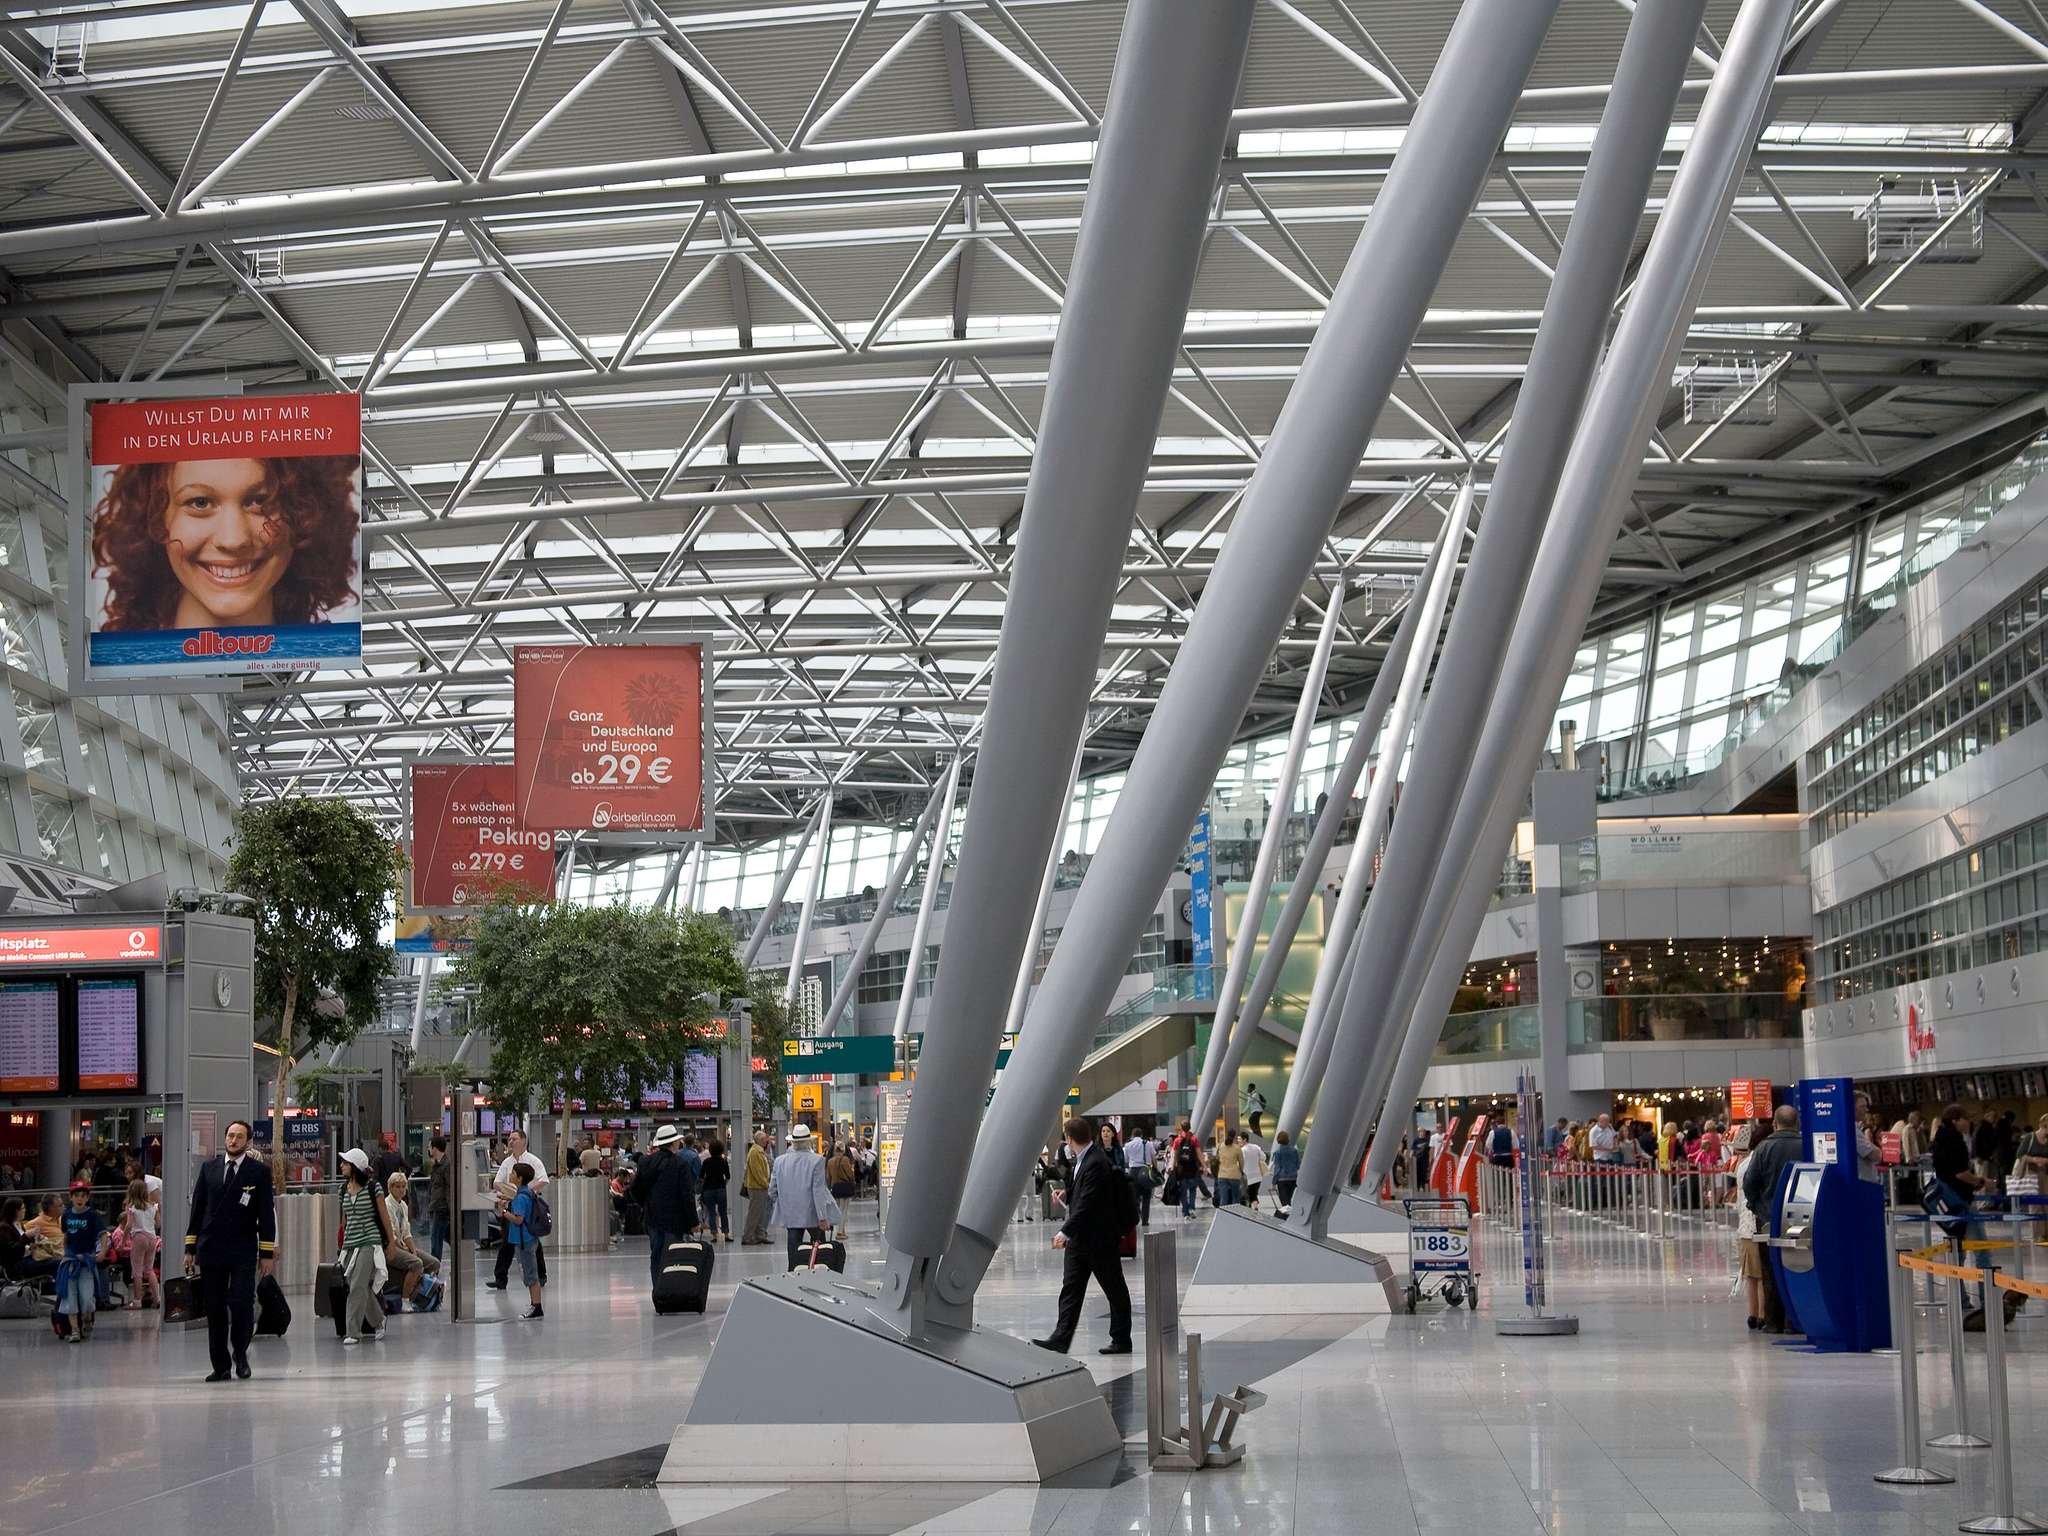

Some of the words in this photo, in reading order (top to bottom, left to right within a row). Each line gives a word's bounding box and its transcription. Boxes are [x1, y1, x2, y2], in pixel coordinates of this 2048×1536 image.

[183, 631, 275, 657] alltours
[247, 661, 264, 670] alles
[271, 661, 288, 670] aber
[291, 660, 321, 671] günstig
[569, 710, 604, 722] Ganz
[591, 725, 674, 737] Deutschland
[582, 741, 606, 752] und
[611, 741, 658, 754] Europa
[571, 768, 595, 784] ab
[598, 754, 641, 784] 29
[647, 757, 673, 784] €
[452, 815, 496, 826] nonstop
[611, 812, 676, 822] airberlin.com
[480, 827, 551, 851] Peking
[452, 860, 466, 871] ab
[469, 852, 506, 871] 279
[510, 854, 525, 870] €
[119, 950, 155, 958] vodafone
[814, 1041, 844, 1049] Ausgang
[301, 1123, 320, 1133] RBS
